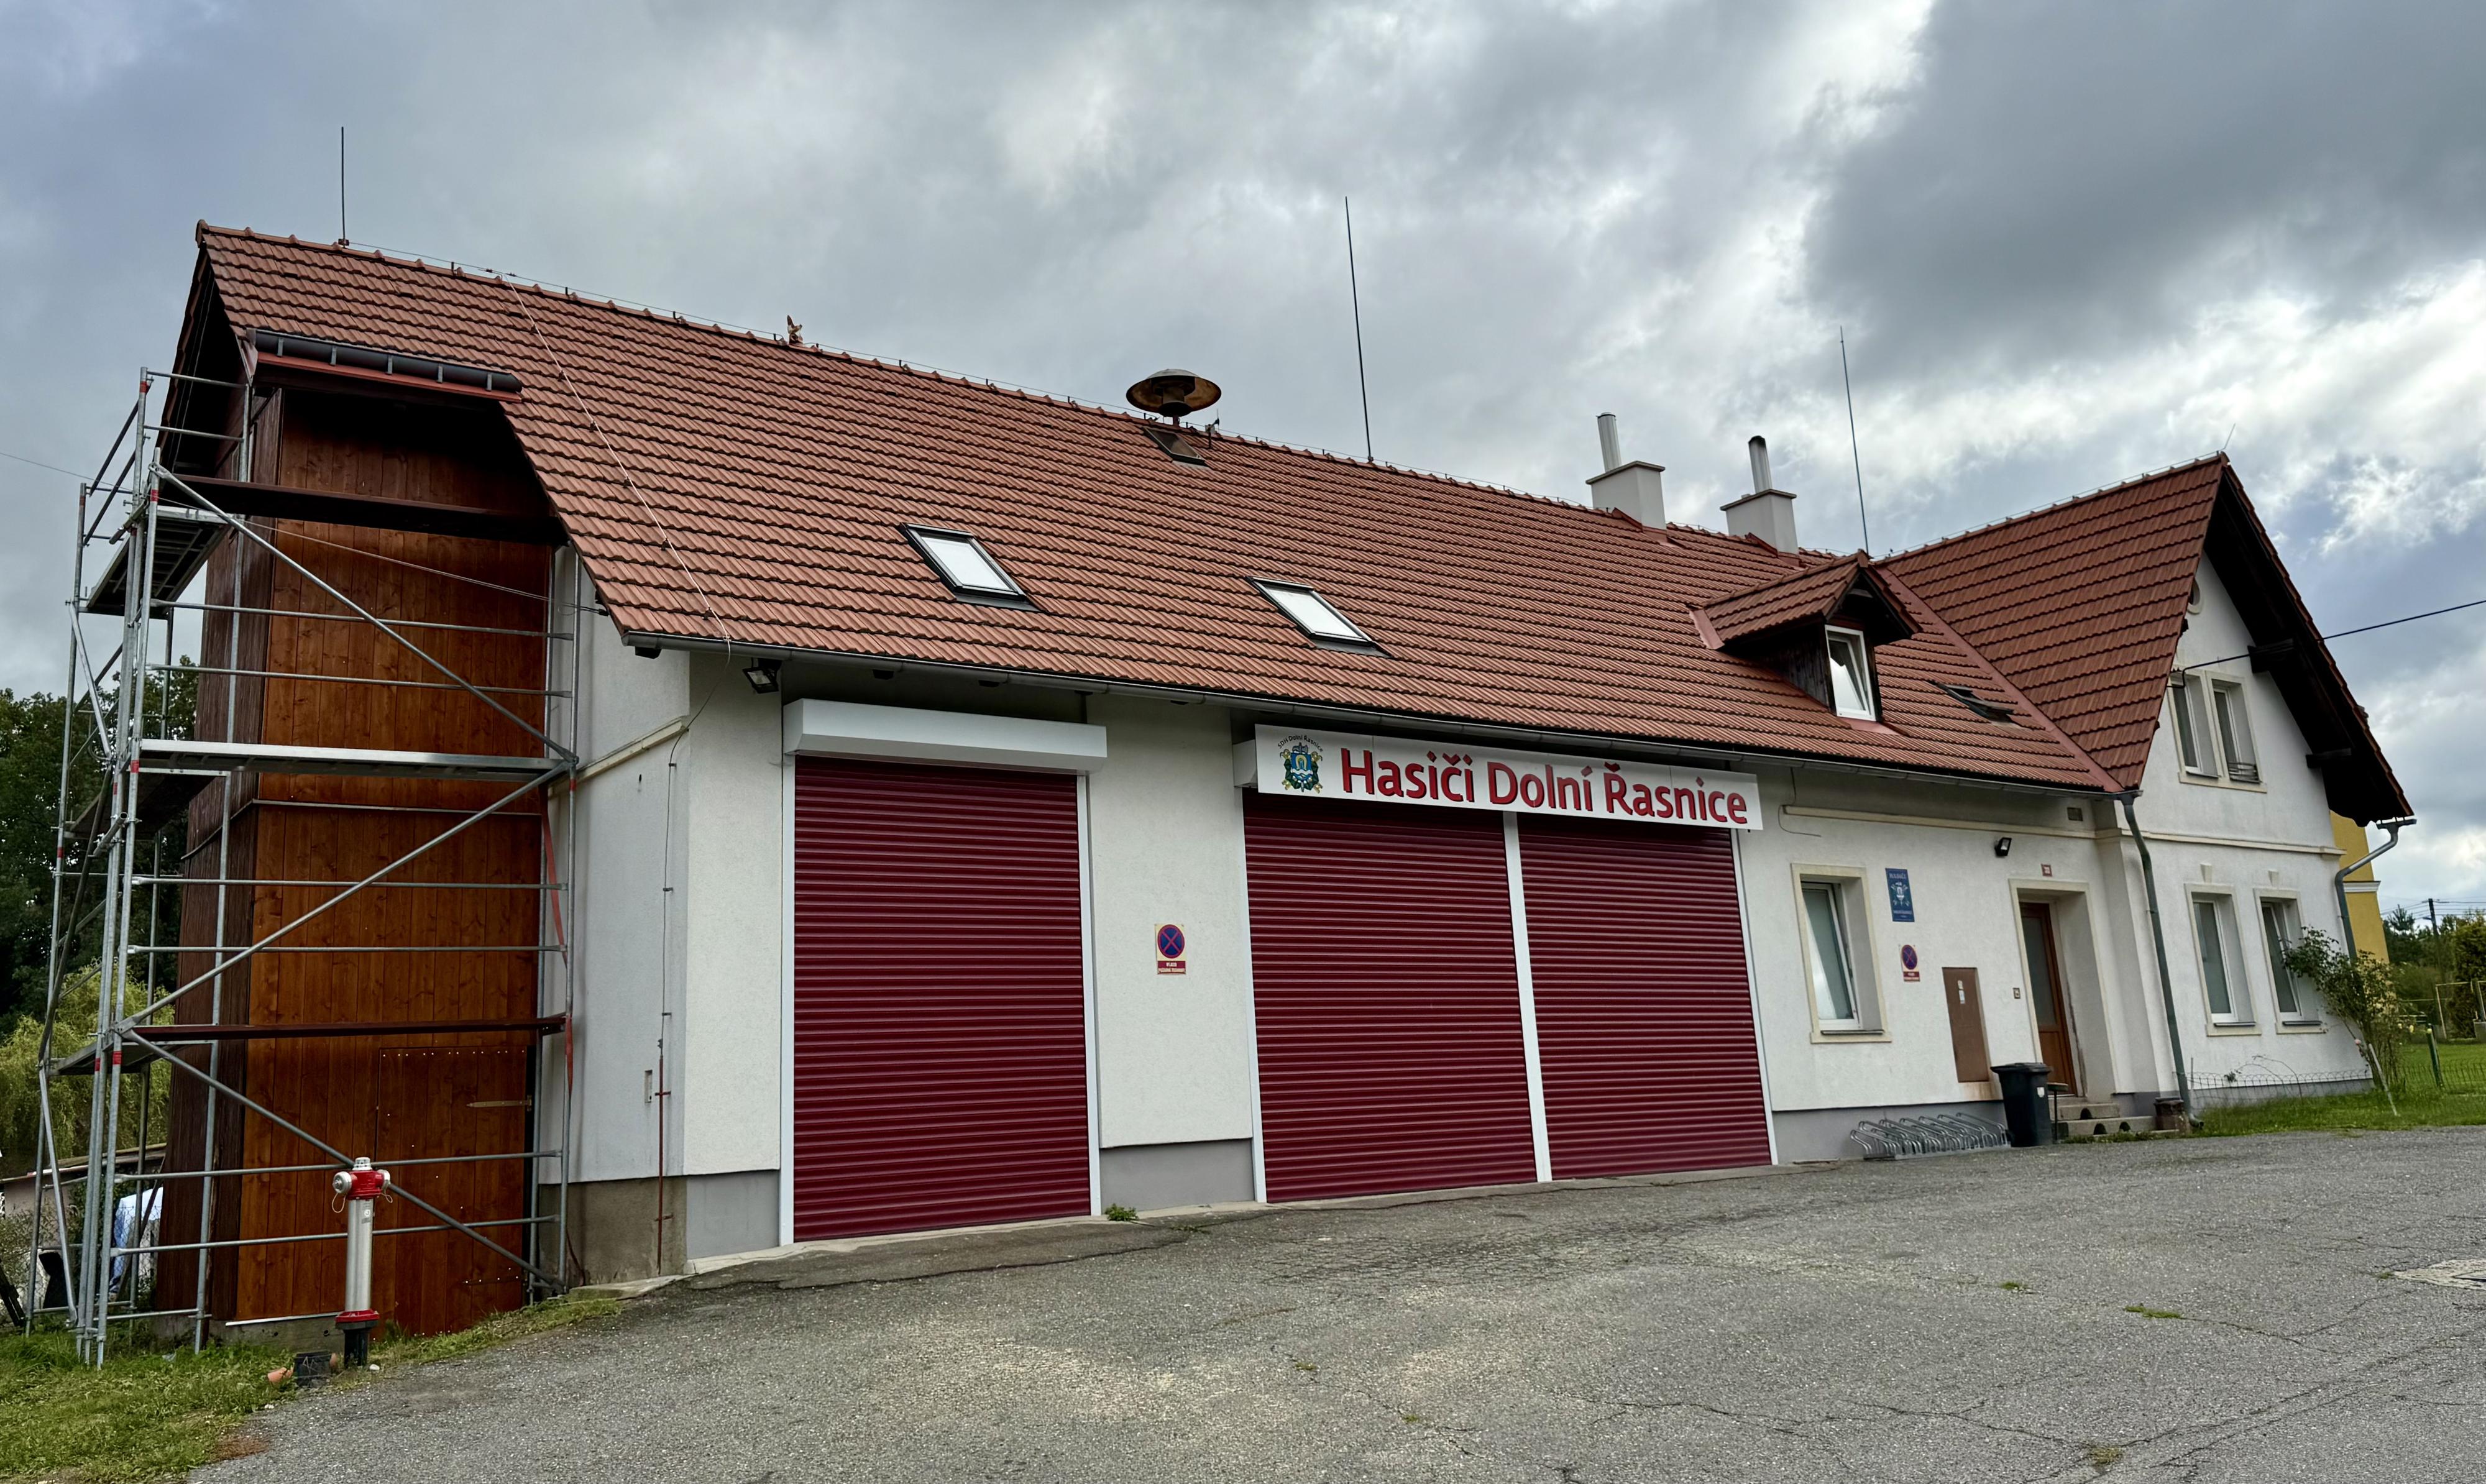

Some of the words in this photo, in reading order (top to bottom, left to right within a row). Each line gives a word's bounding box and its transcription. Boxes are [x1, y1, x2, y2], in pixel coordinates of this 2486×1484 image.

[1277, 738, 1288, 749] SDH
[1341, 748, 1475, 803] Hasiči
[1487, 761, 1593, 812] Dolní
[1603, 761, 1748, 824] Řasnice
